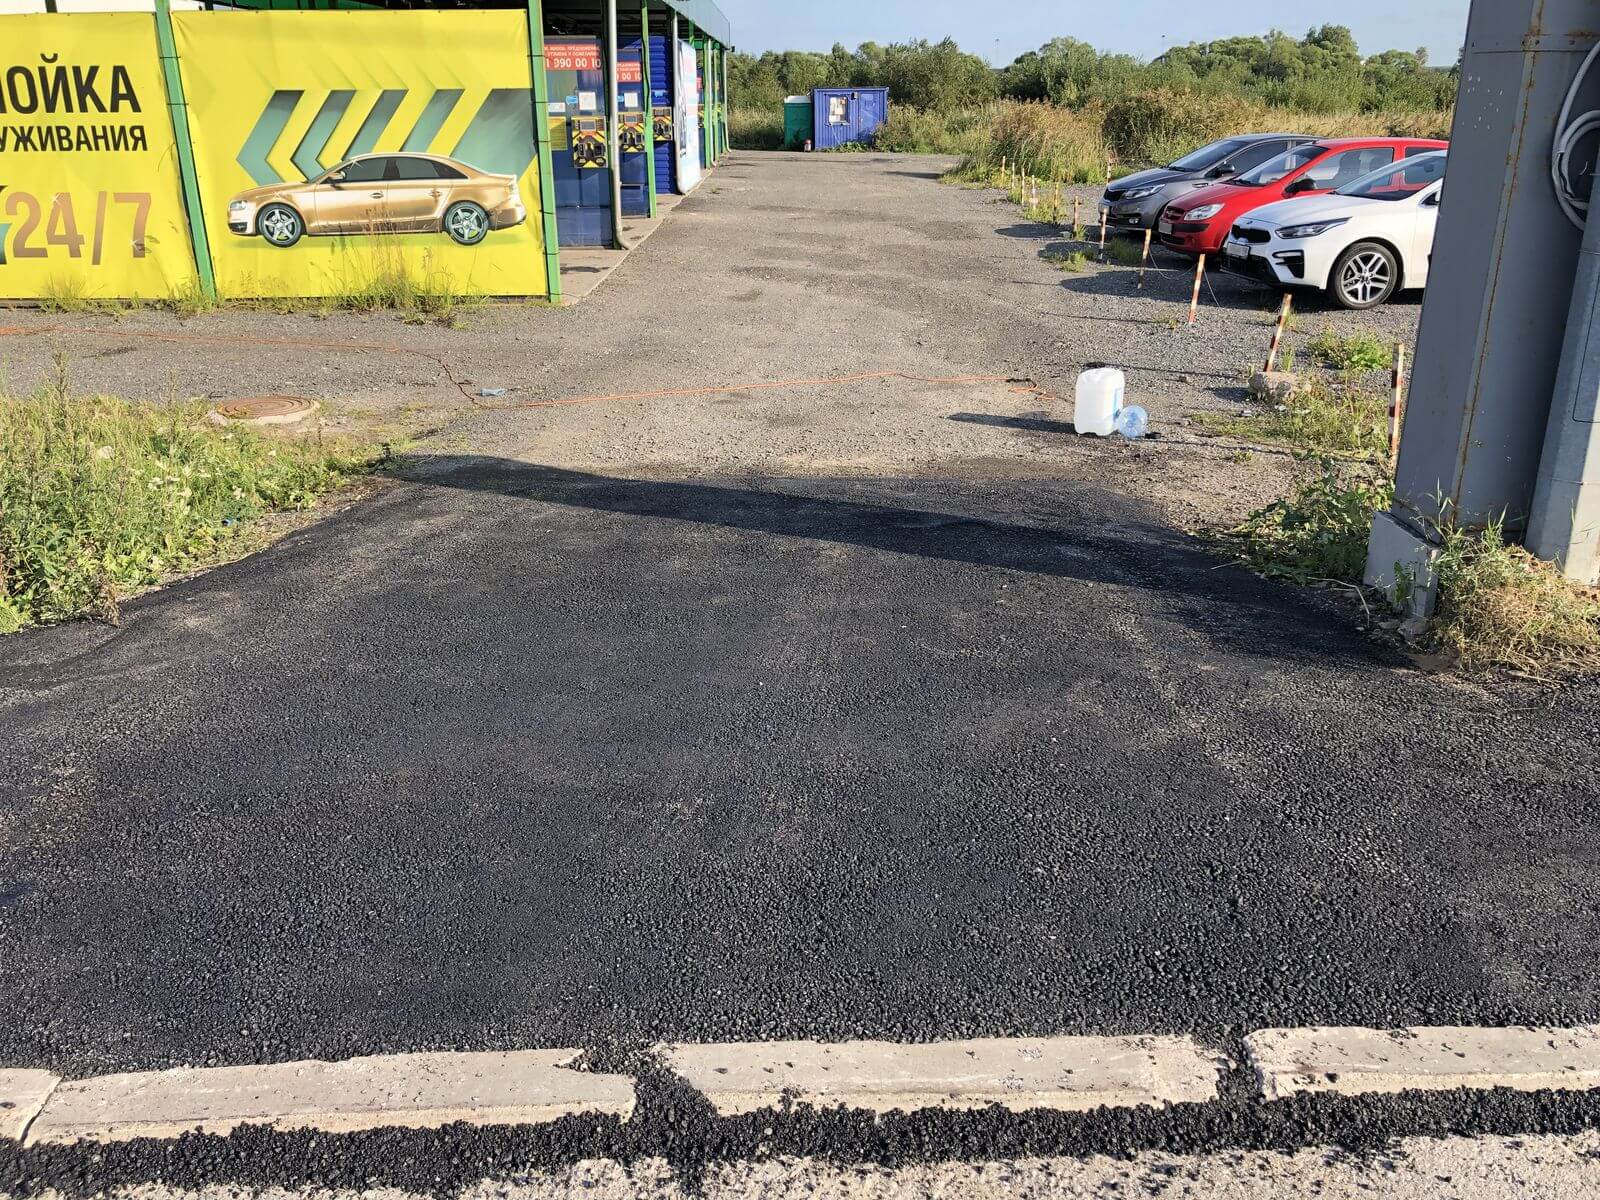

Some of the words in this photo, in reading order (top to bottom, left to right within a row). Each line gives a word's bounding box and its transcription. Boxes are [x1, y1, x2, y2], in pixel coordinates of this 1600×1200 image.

[0, 53, 142, 114] ОЙКА
[575, 58, 588, 68] 00
[591, 58, 601, 68] 10
[5, 190, 152, 266] 24/7
